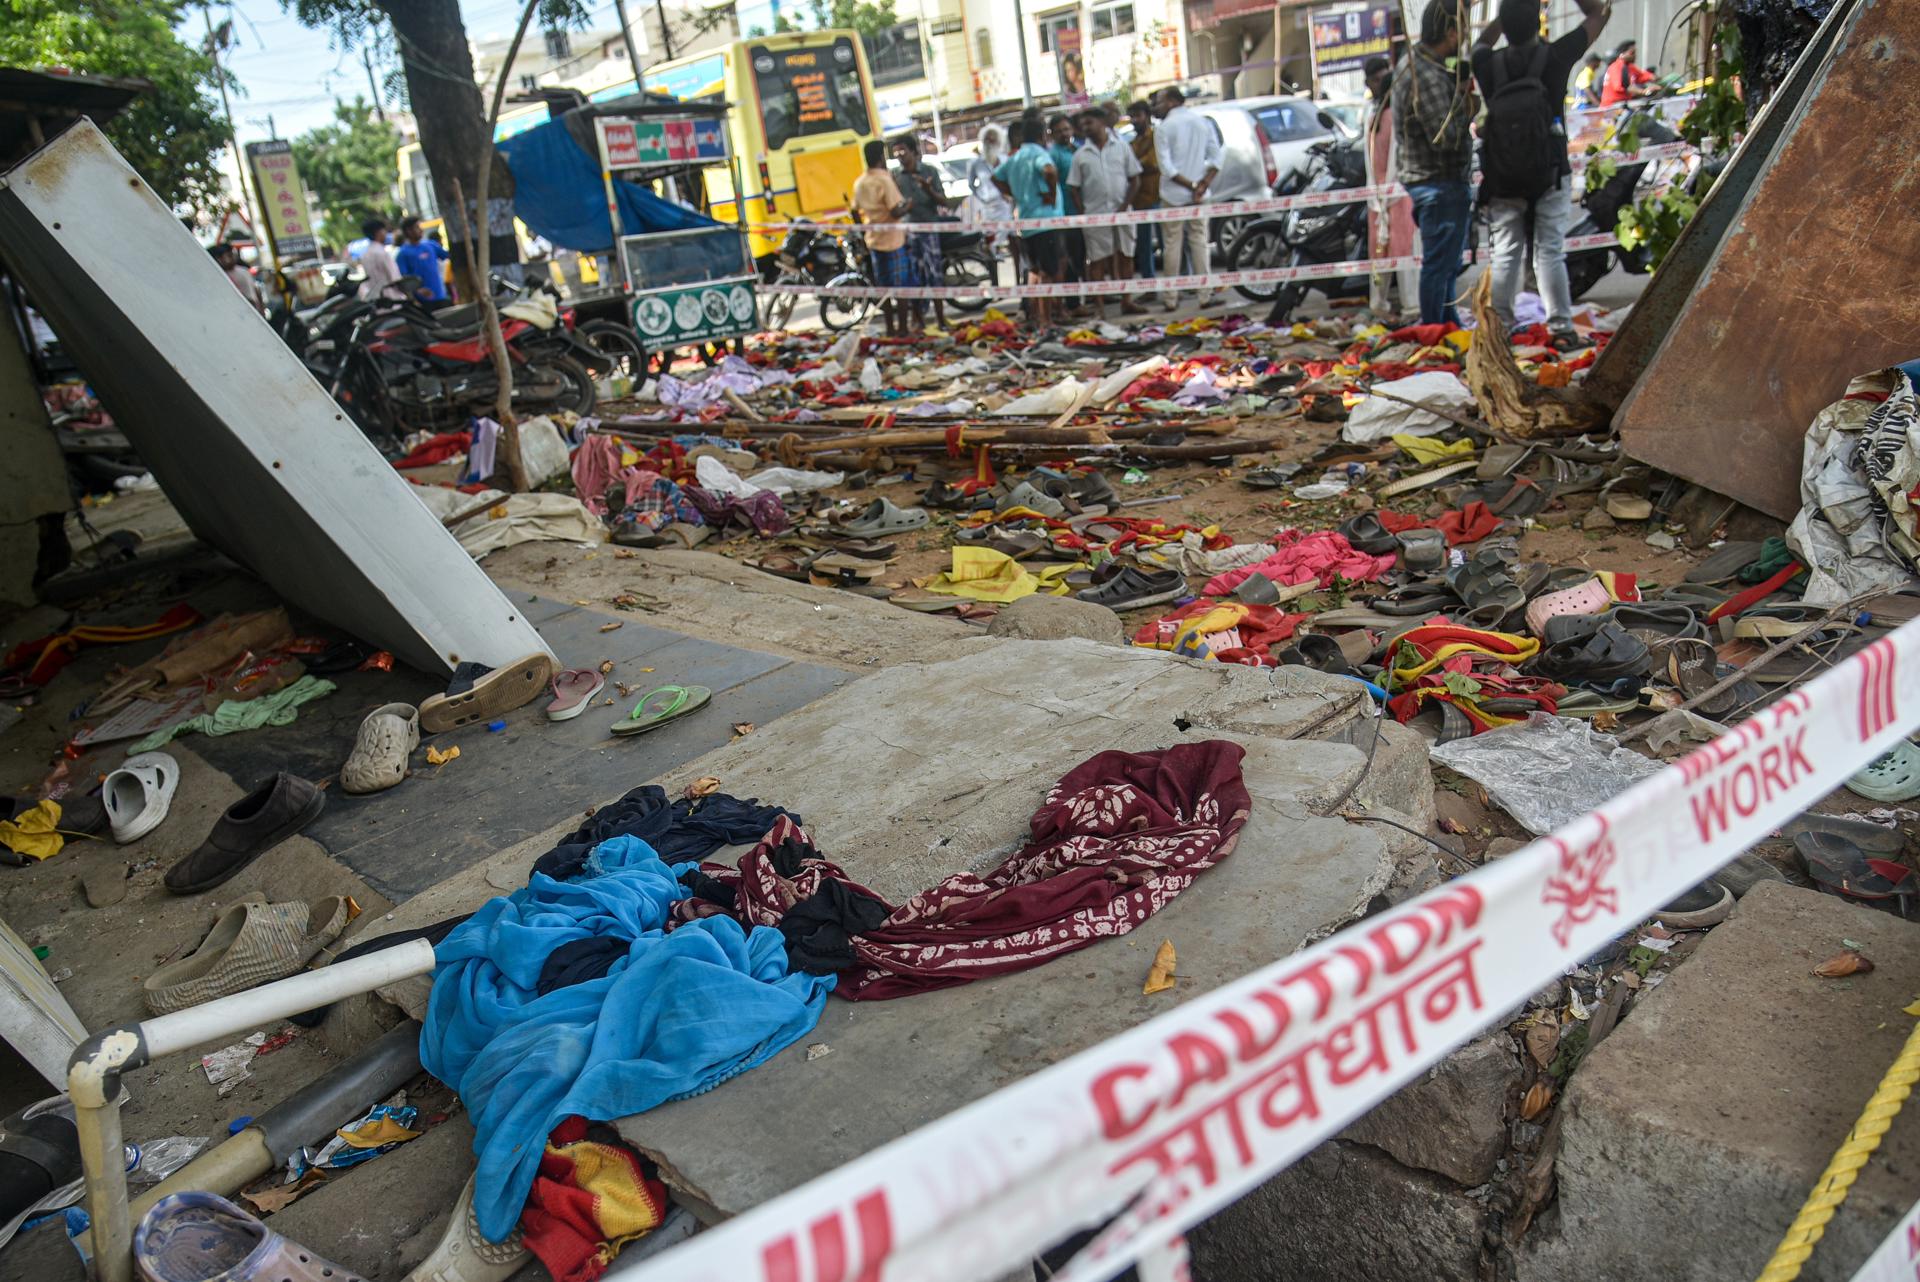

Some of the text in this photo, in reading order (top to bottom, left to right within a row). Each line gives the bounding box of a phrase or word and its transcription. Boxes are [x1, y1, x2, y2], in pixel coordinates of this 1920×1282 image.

[1690, 725, 1816, 844] WORK
[1090, 884, 1485, 1141] CAUTION
[1107, 938, 1485, 1187] सावधान
